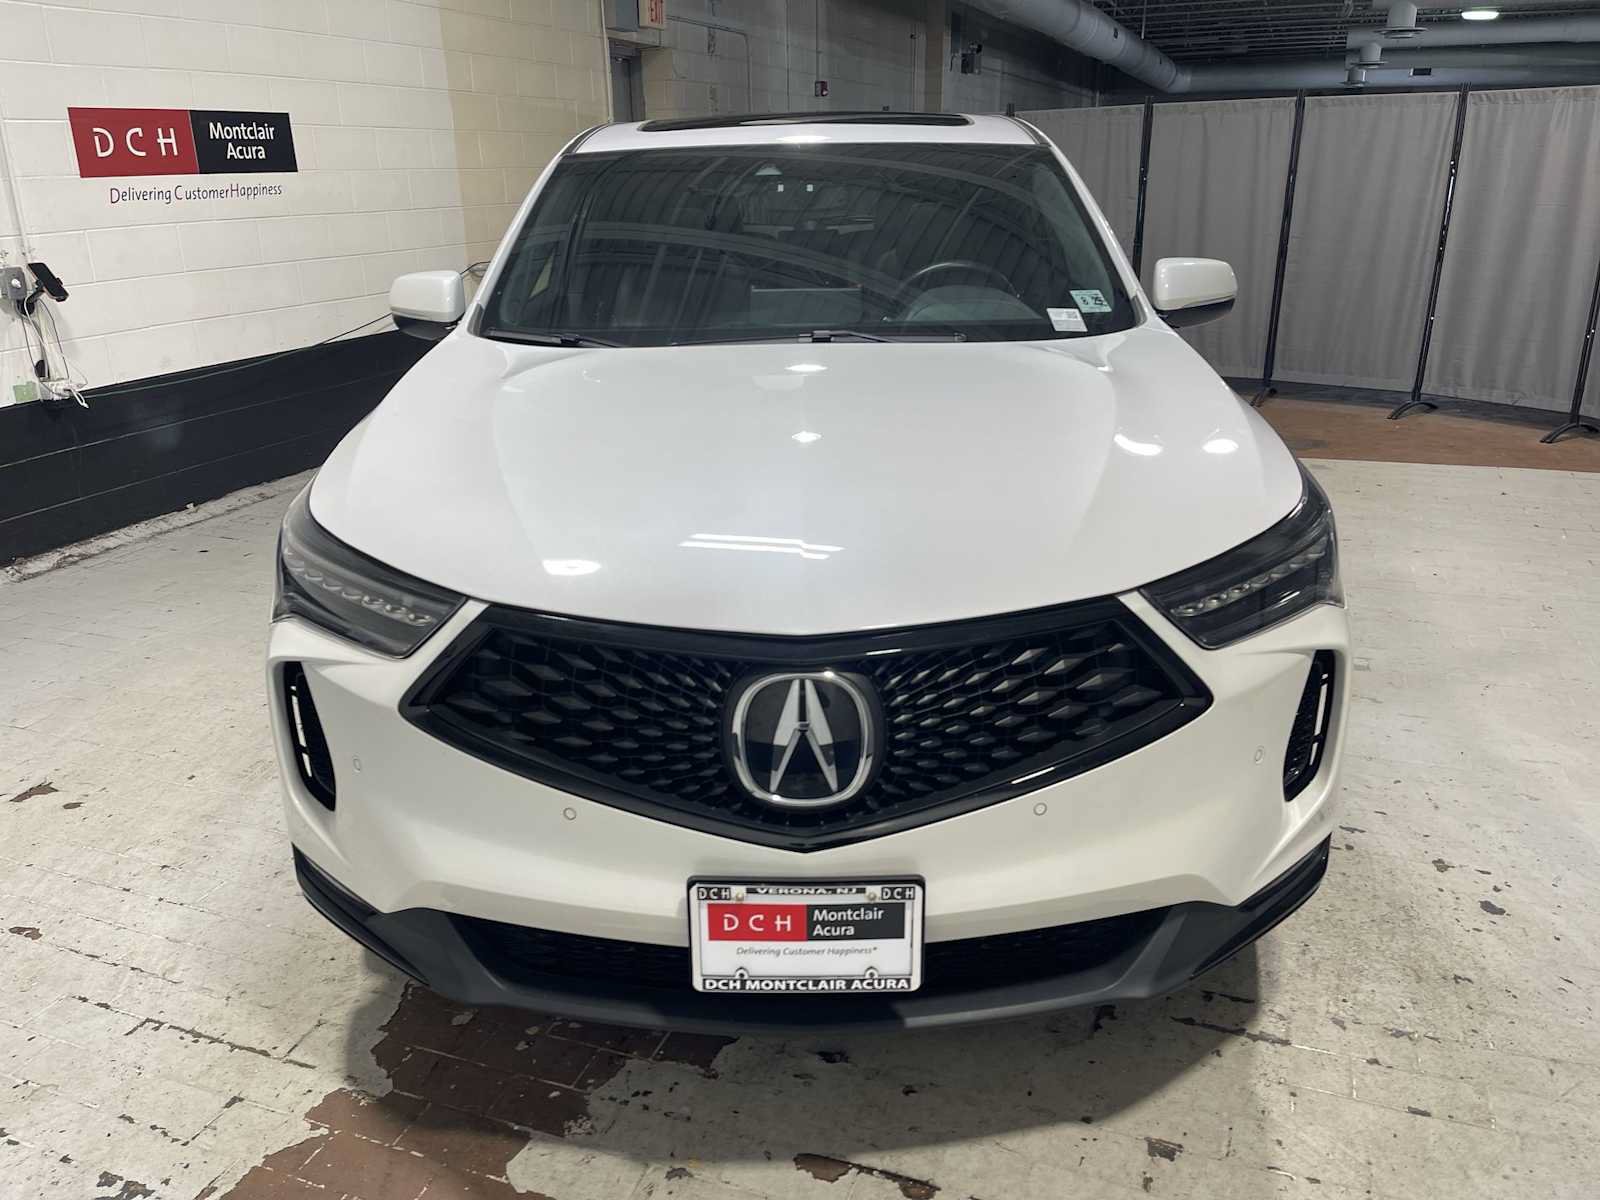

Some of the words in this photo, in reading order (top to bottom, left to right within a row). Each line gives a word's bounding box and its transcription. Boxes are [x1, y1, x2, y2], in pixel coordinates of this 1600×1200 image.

[208, 122, 275, 140] Montclair
[226, 143, 266, 160] Acura
[109, 186, 172, 205] Delivering
[174, 185, 229, 201] Customer
[229, 183, 283, 198] Happiness
[698, 887, 731, 900] DCH
[836, 887, 858, 895] NJ
[882, 887, 914, 900] DCH
[813, 907, 885, 922] Montclair
[813, 924, 855, 937] Acura
[736, 947, 781, 957] Delivering
[783, 947, 826, 956] Customer
[704, 979, 741, 991] DCH
[745, 979, 847, 991] MONTCLAIR
[850, 978, 910, 990] ACURA
